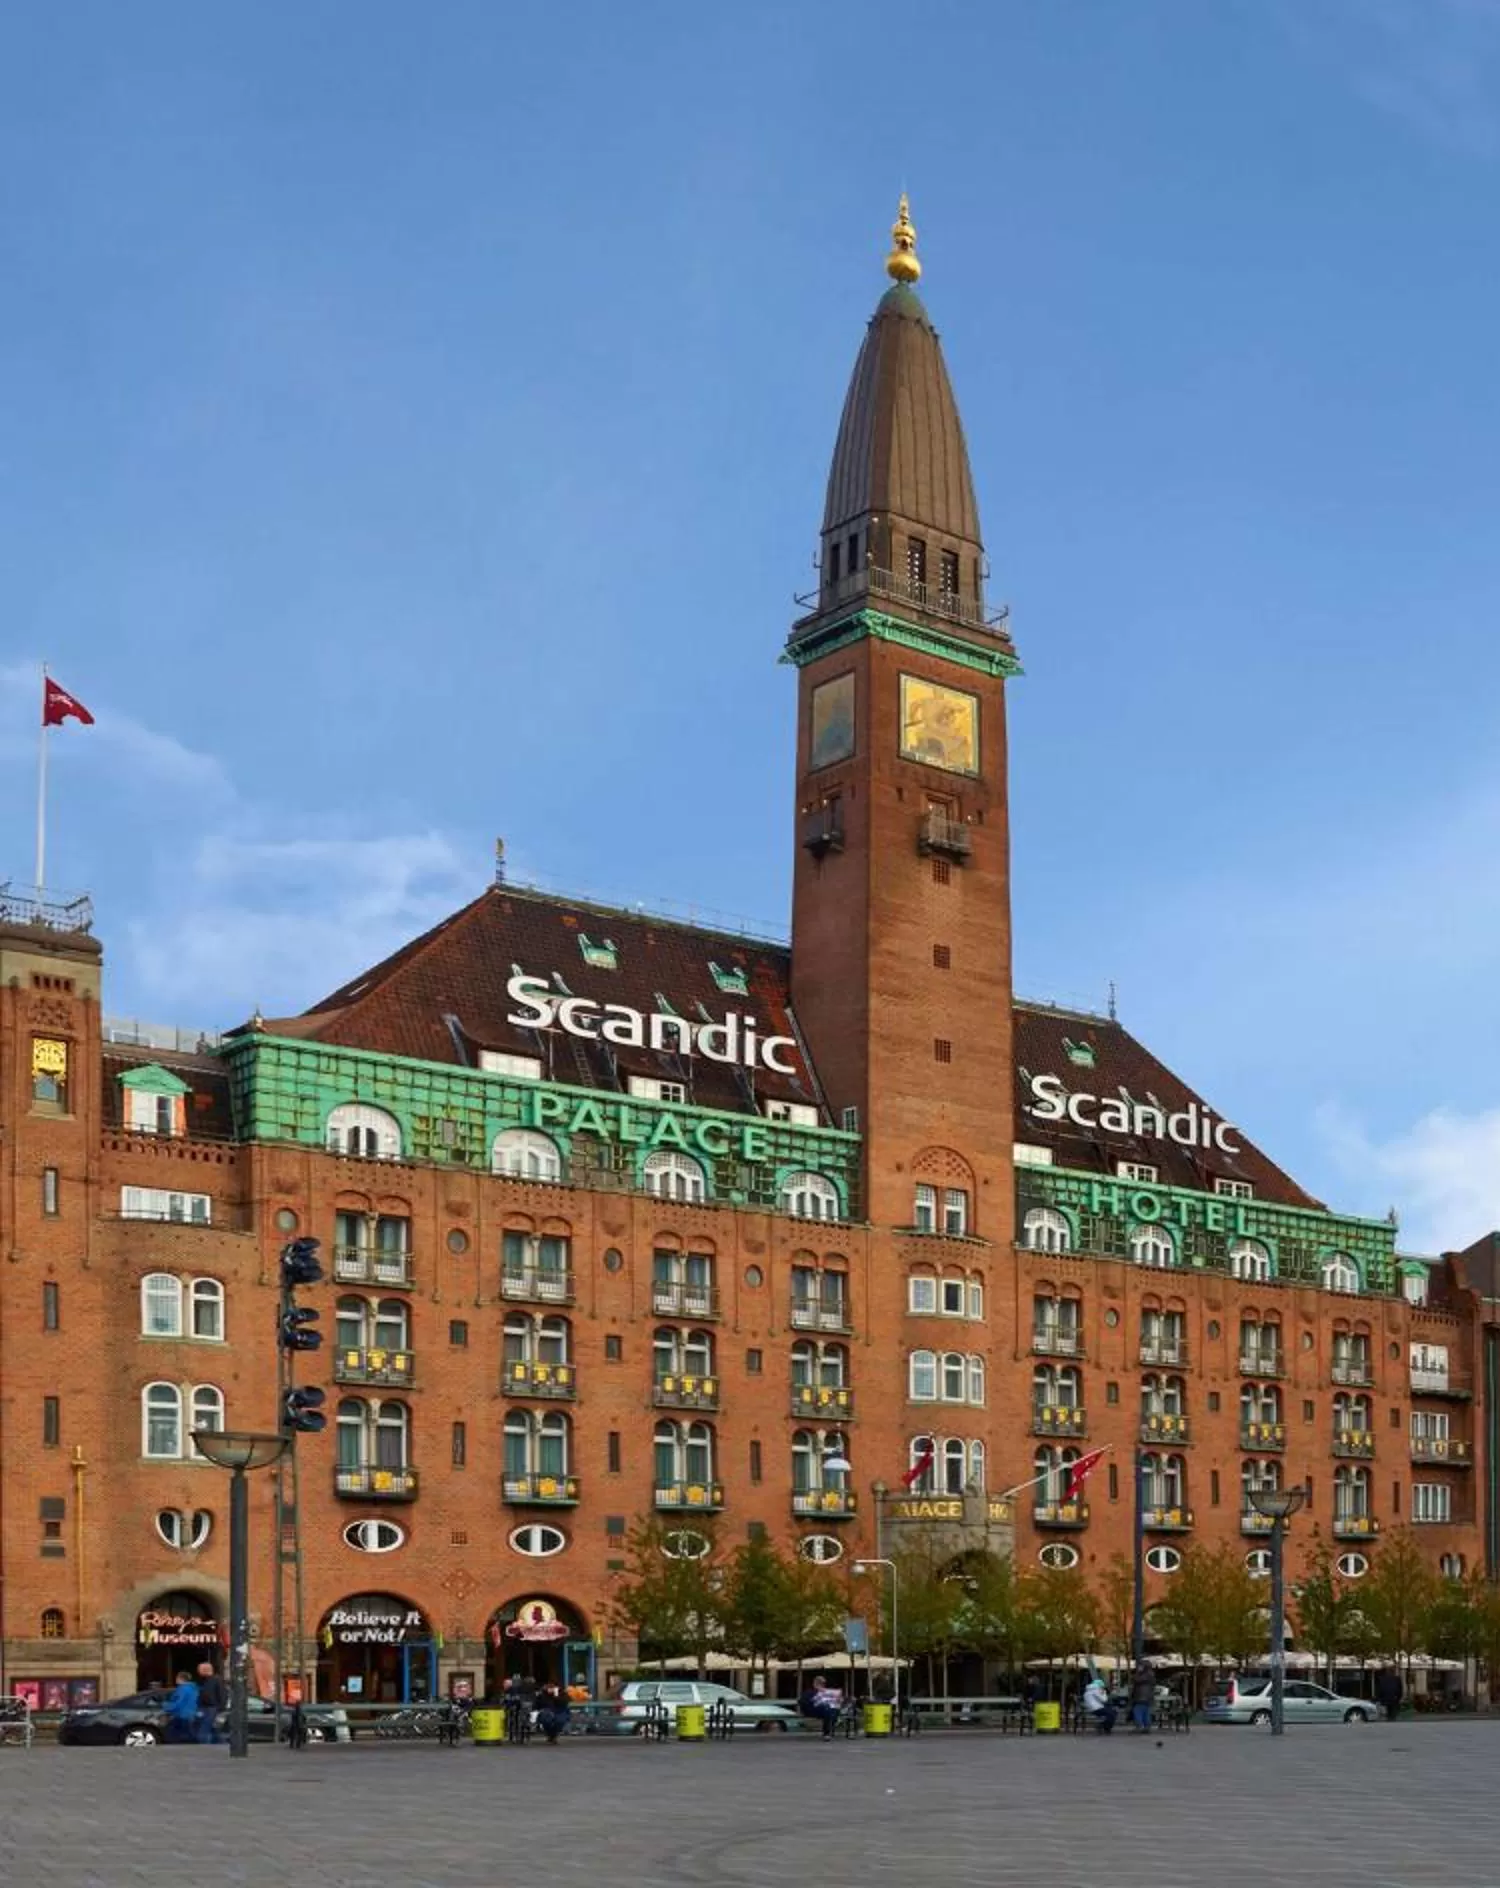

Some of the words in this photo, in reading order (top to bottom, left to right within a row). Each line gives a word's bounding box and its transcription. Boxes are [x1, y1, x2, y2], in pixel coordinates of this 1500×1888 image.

[507, 975, 796, 1074] Scandic
[532, 1090, 768, 1161] PALACE
[1031, 1075, 1241, 1153] Scandic
[1090, 1180, 1257, 1237] HOTEL
[139, 1629, 217, 1643] Museum
[330, 1611, 401, 1625] Believe
[404, 1611, 421, 1625] It
[340, 1631, 363, 1642] or
[364, 1628, 406, 1642] Not!
